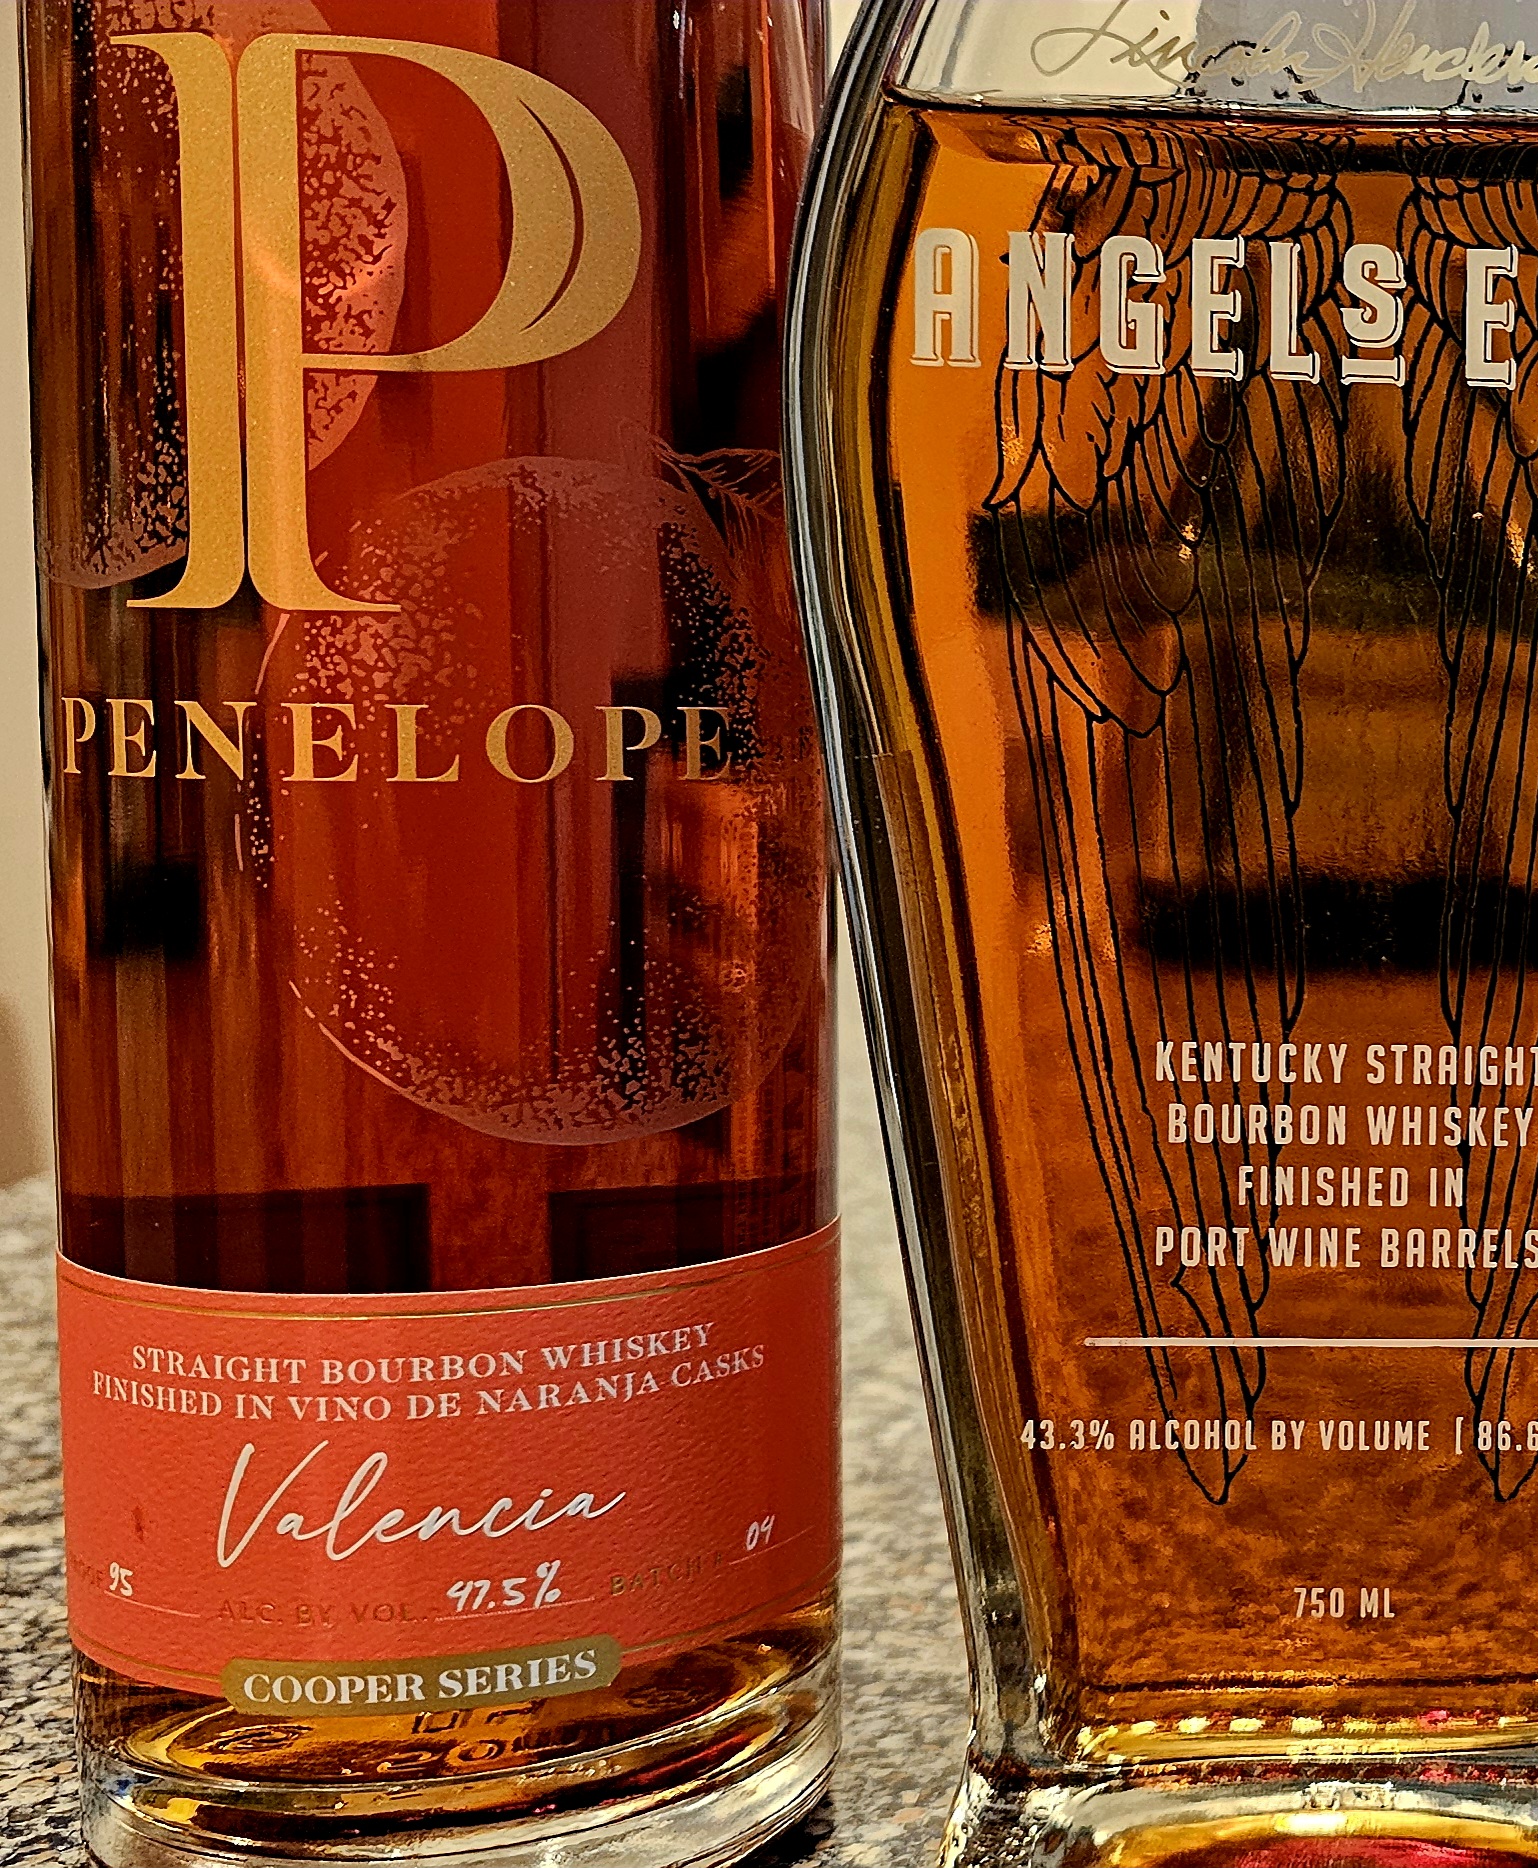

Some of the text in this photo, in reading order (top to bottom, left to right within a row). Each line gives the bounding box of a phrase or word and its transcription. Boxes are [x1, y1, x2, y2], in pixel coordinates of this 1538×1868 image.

[911, 227, 1408, 388] ANGELS
[60, 697, 739, 784] PENELOPE
[1155, 1041, 1349, 1084] KENTUCKY
[1168, 1103, 1534, 1148] BOURBON WHISKEY
[1238, 1165, 1465, 1208] FINISHED IN
[1155, 1226, 1250, 1268] PORT
[1268, 1226, 1362, 1268] WINE
[132, 1322, 715, 1386] STRAIGHT BOURBON WHISKEY
[92, 1344, 765, 1422] FINISHED IN VINO DE NARANJA CASKS
[1019, 1418, 1115, 1452] 43.3%
[1129, 1419, 1257, 1452] ALCOHOL
[1271, 1419, 1305, 1452] BY
[1319, 1419, 1431, 1452] VOLUME
[215, 1440, 627, 1571] Valencia
[745, 1514, 775, 1551] 04
[109, 1561, 134, 1597] 95
[447, 1559, 562, 1612] 47.5%
[1293, 1586, 1396, 1619] 750 ML
[243, 1649, 599, 1705] COOPER SERIES
